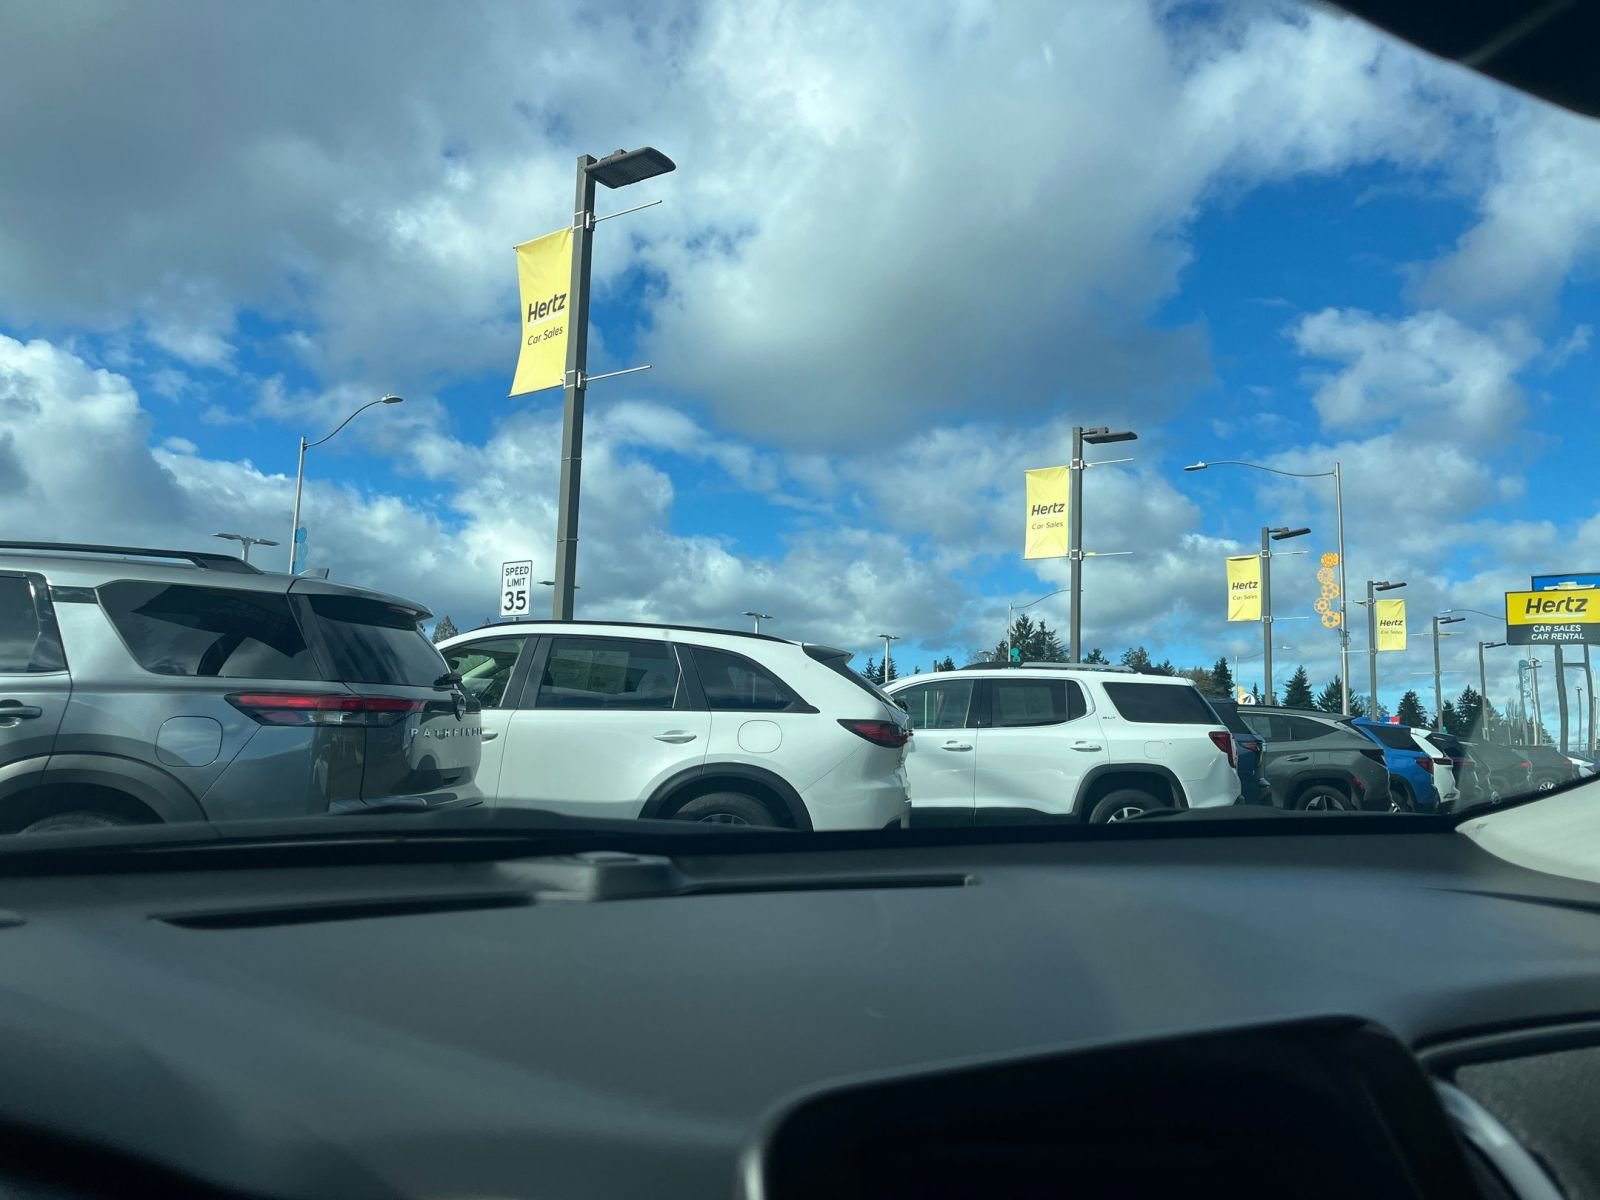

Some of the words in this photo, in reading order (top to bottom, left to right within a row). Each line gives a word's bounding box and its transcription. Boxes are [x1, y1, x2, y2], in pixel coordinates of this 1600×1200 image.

[527, 293, 567, 323] Hertz
[527, 335, 542, 346] Car
[543, 326, 564, 341] Sales
[1031, 502, 1066, 516] Hertz
[1046, 521, 1064, 529] Sales
[505, 566, 530, 576] SPEED
[506, 577, 526, 587] LIMIT
[1231, 580, 1259, 591] Hertz
[503, 590, 527, 611] 35
[1525, 596, 1589, 615] Hertz
[1379, 619, 1404, 627] Hertz
[1532, 625, 1552, 633] CAR
[1553, 624, 1582, 633] SALES
[1531, 633, 1550, 641] CAR
[1550, 632, 1585, 641] RENTAL
